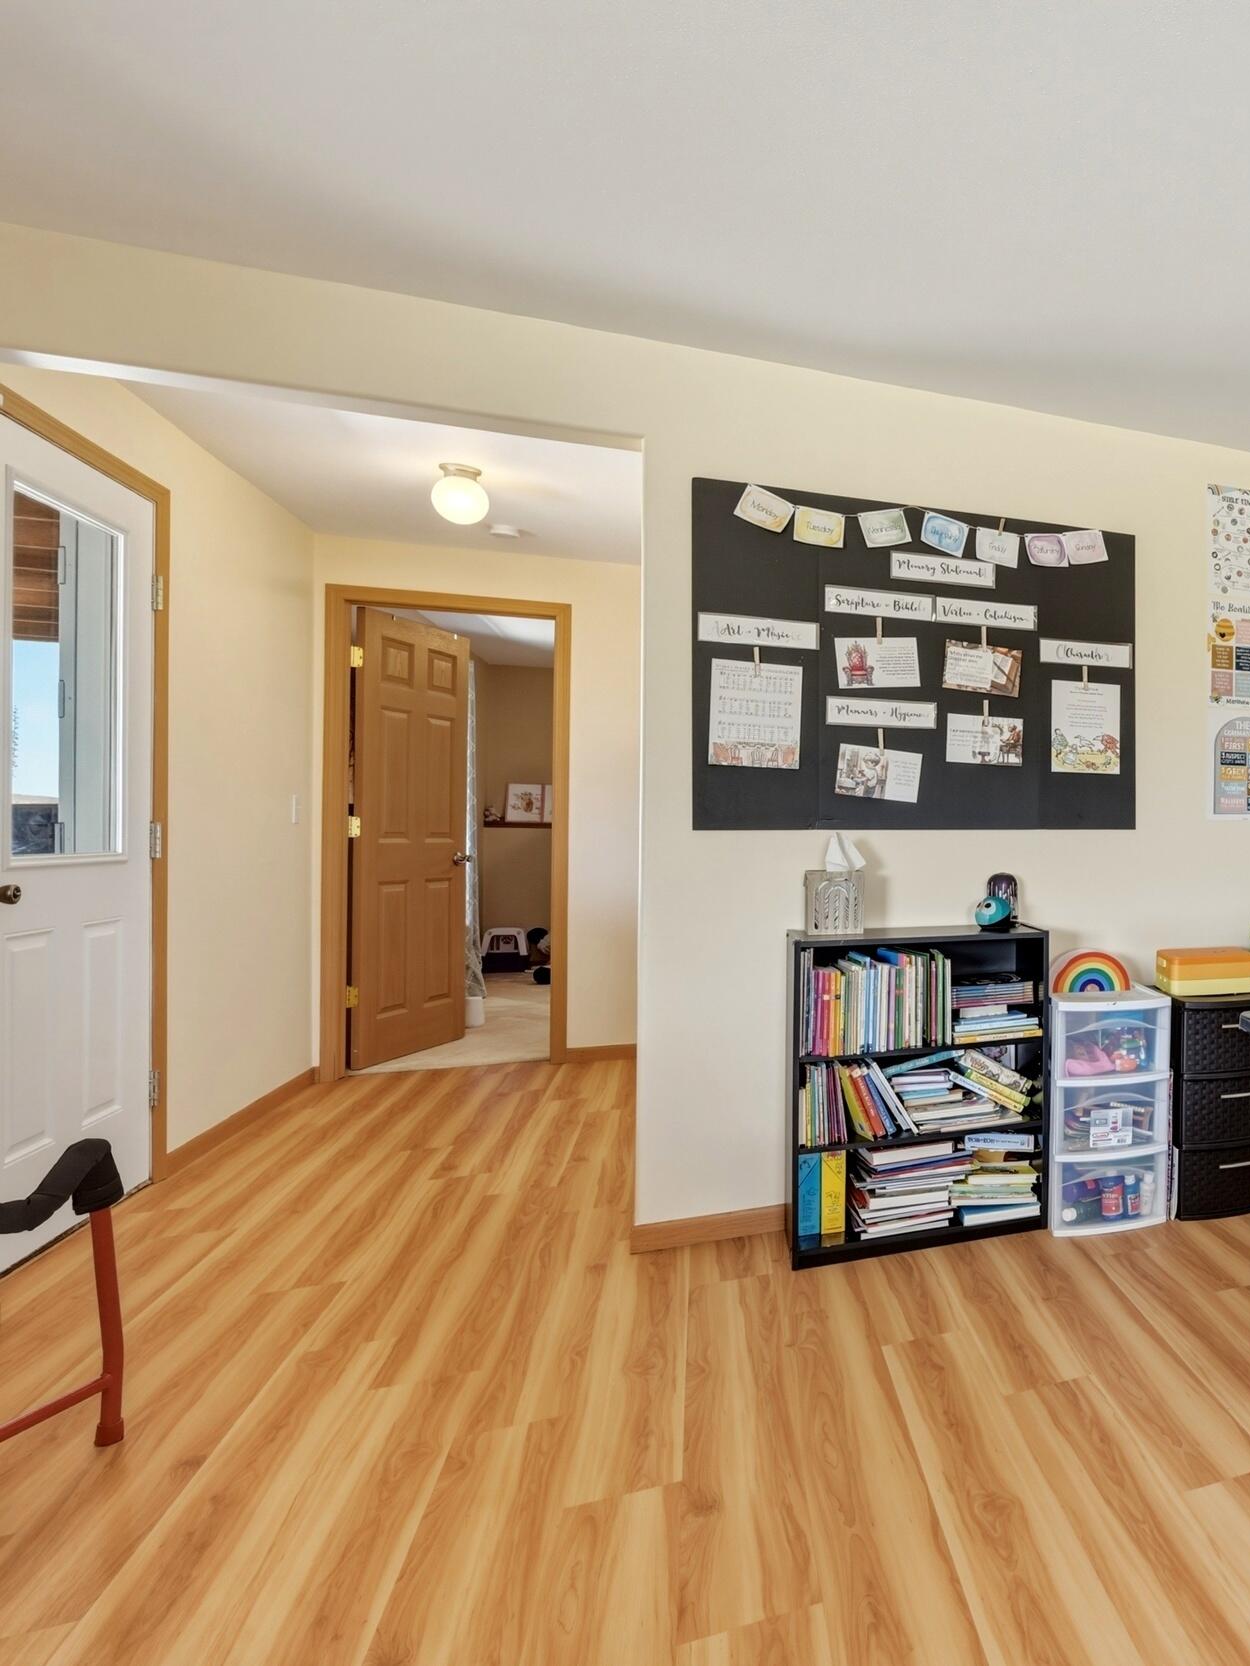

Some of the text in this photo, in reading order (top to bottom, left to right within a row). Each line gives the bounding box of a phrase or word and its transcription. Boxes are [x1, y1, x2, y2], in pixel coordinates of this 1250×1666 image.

[897, 559, 936, 576] Memory
[834, 594, 881, 611] Scripture
[893, 599, 919, 613] Bible
[720, 623, 744, 637] Art
[1235, 720, 1250, 730] THE
[1224, 742, 1245, 750] FIRST
